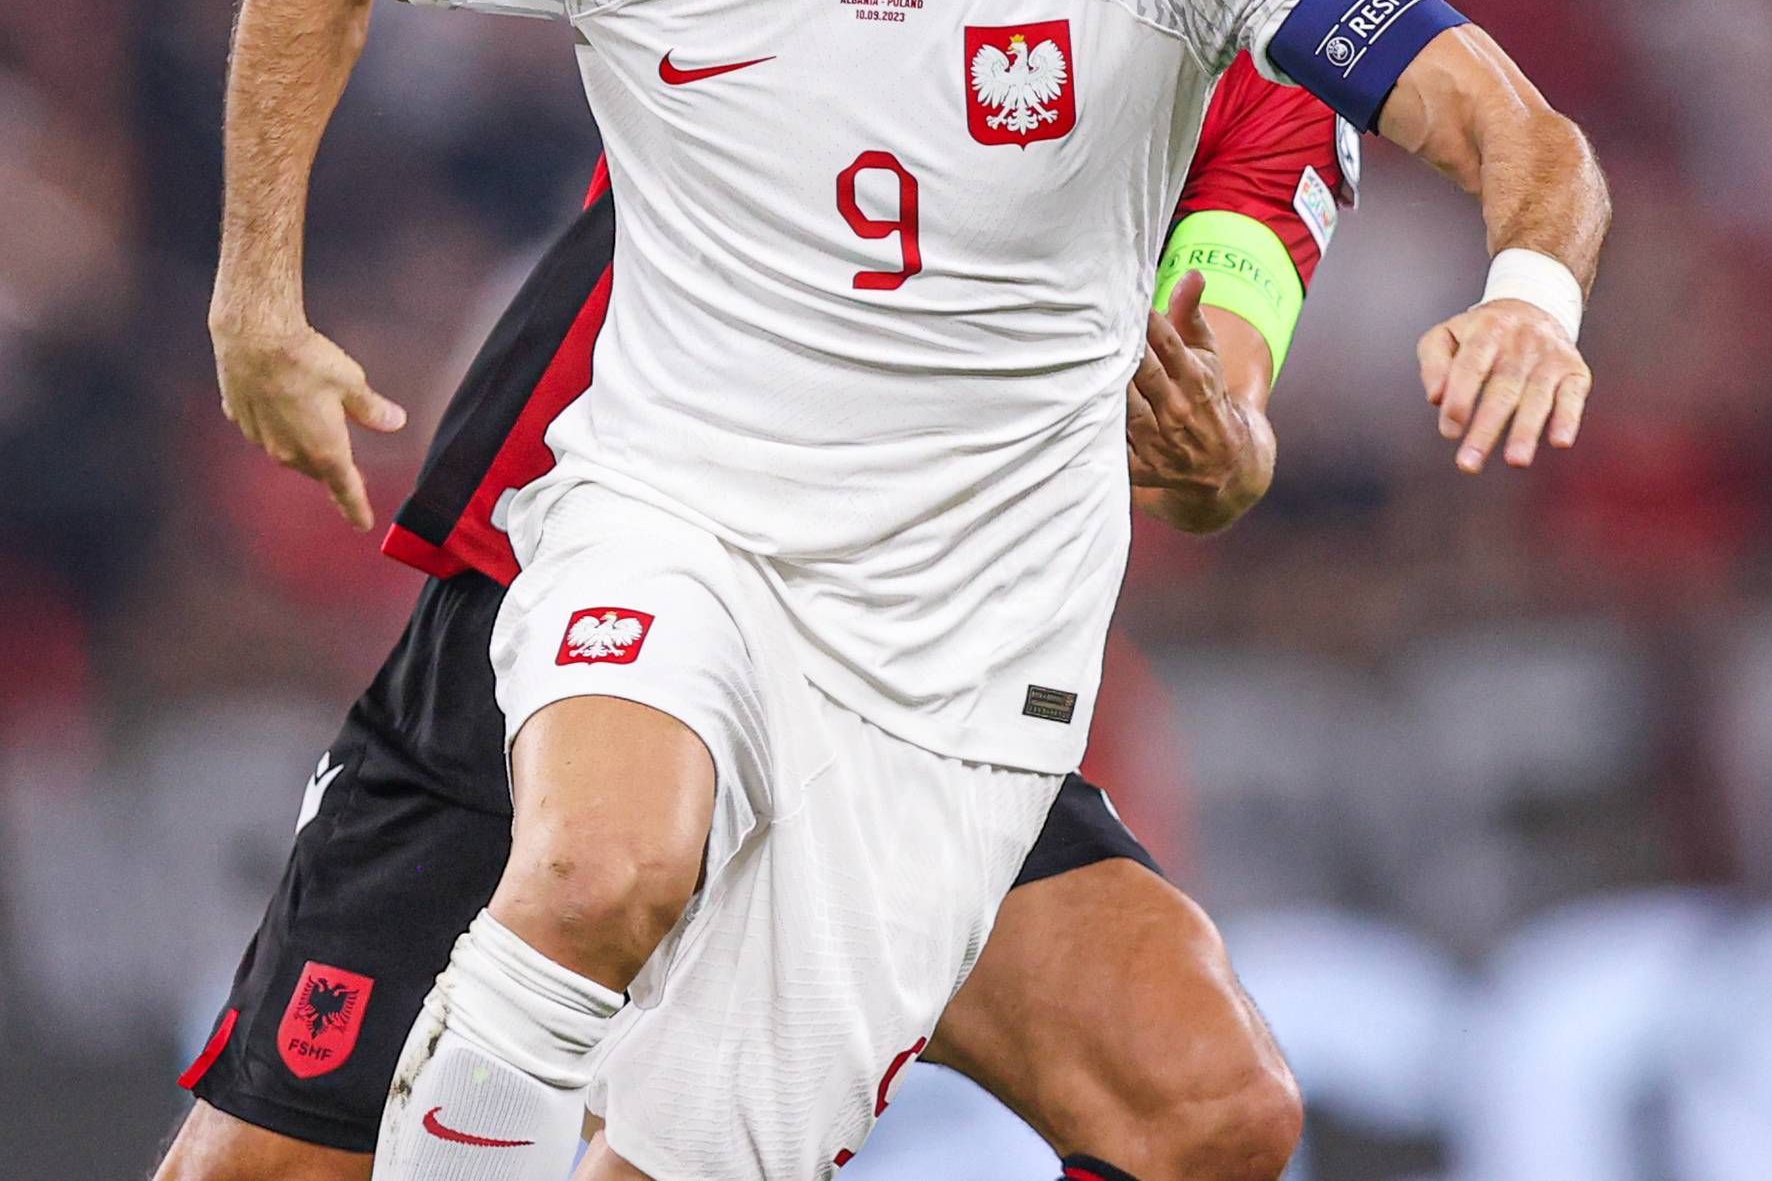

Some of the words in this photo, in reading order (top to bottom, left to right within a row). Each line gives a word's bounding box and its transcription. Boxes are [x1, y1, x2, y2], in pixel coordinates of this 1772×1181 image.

[855, 10, 905, 22] 10.09.2023
[836, 149, 922, 290] 9
[288, 1038, 333, 1061] FSHF
